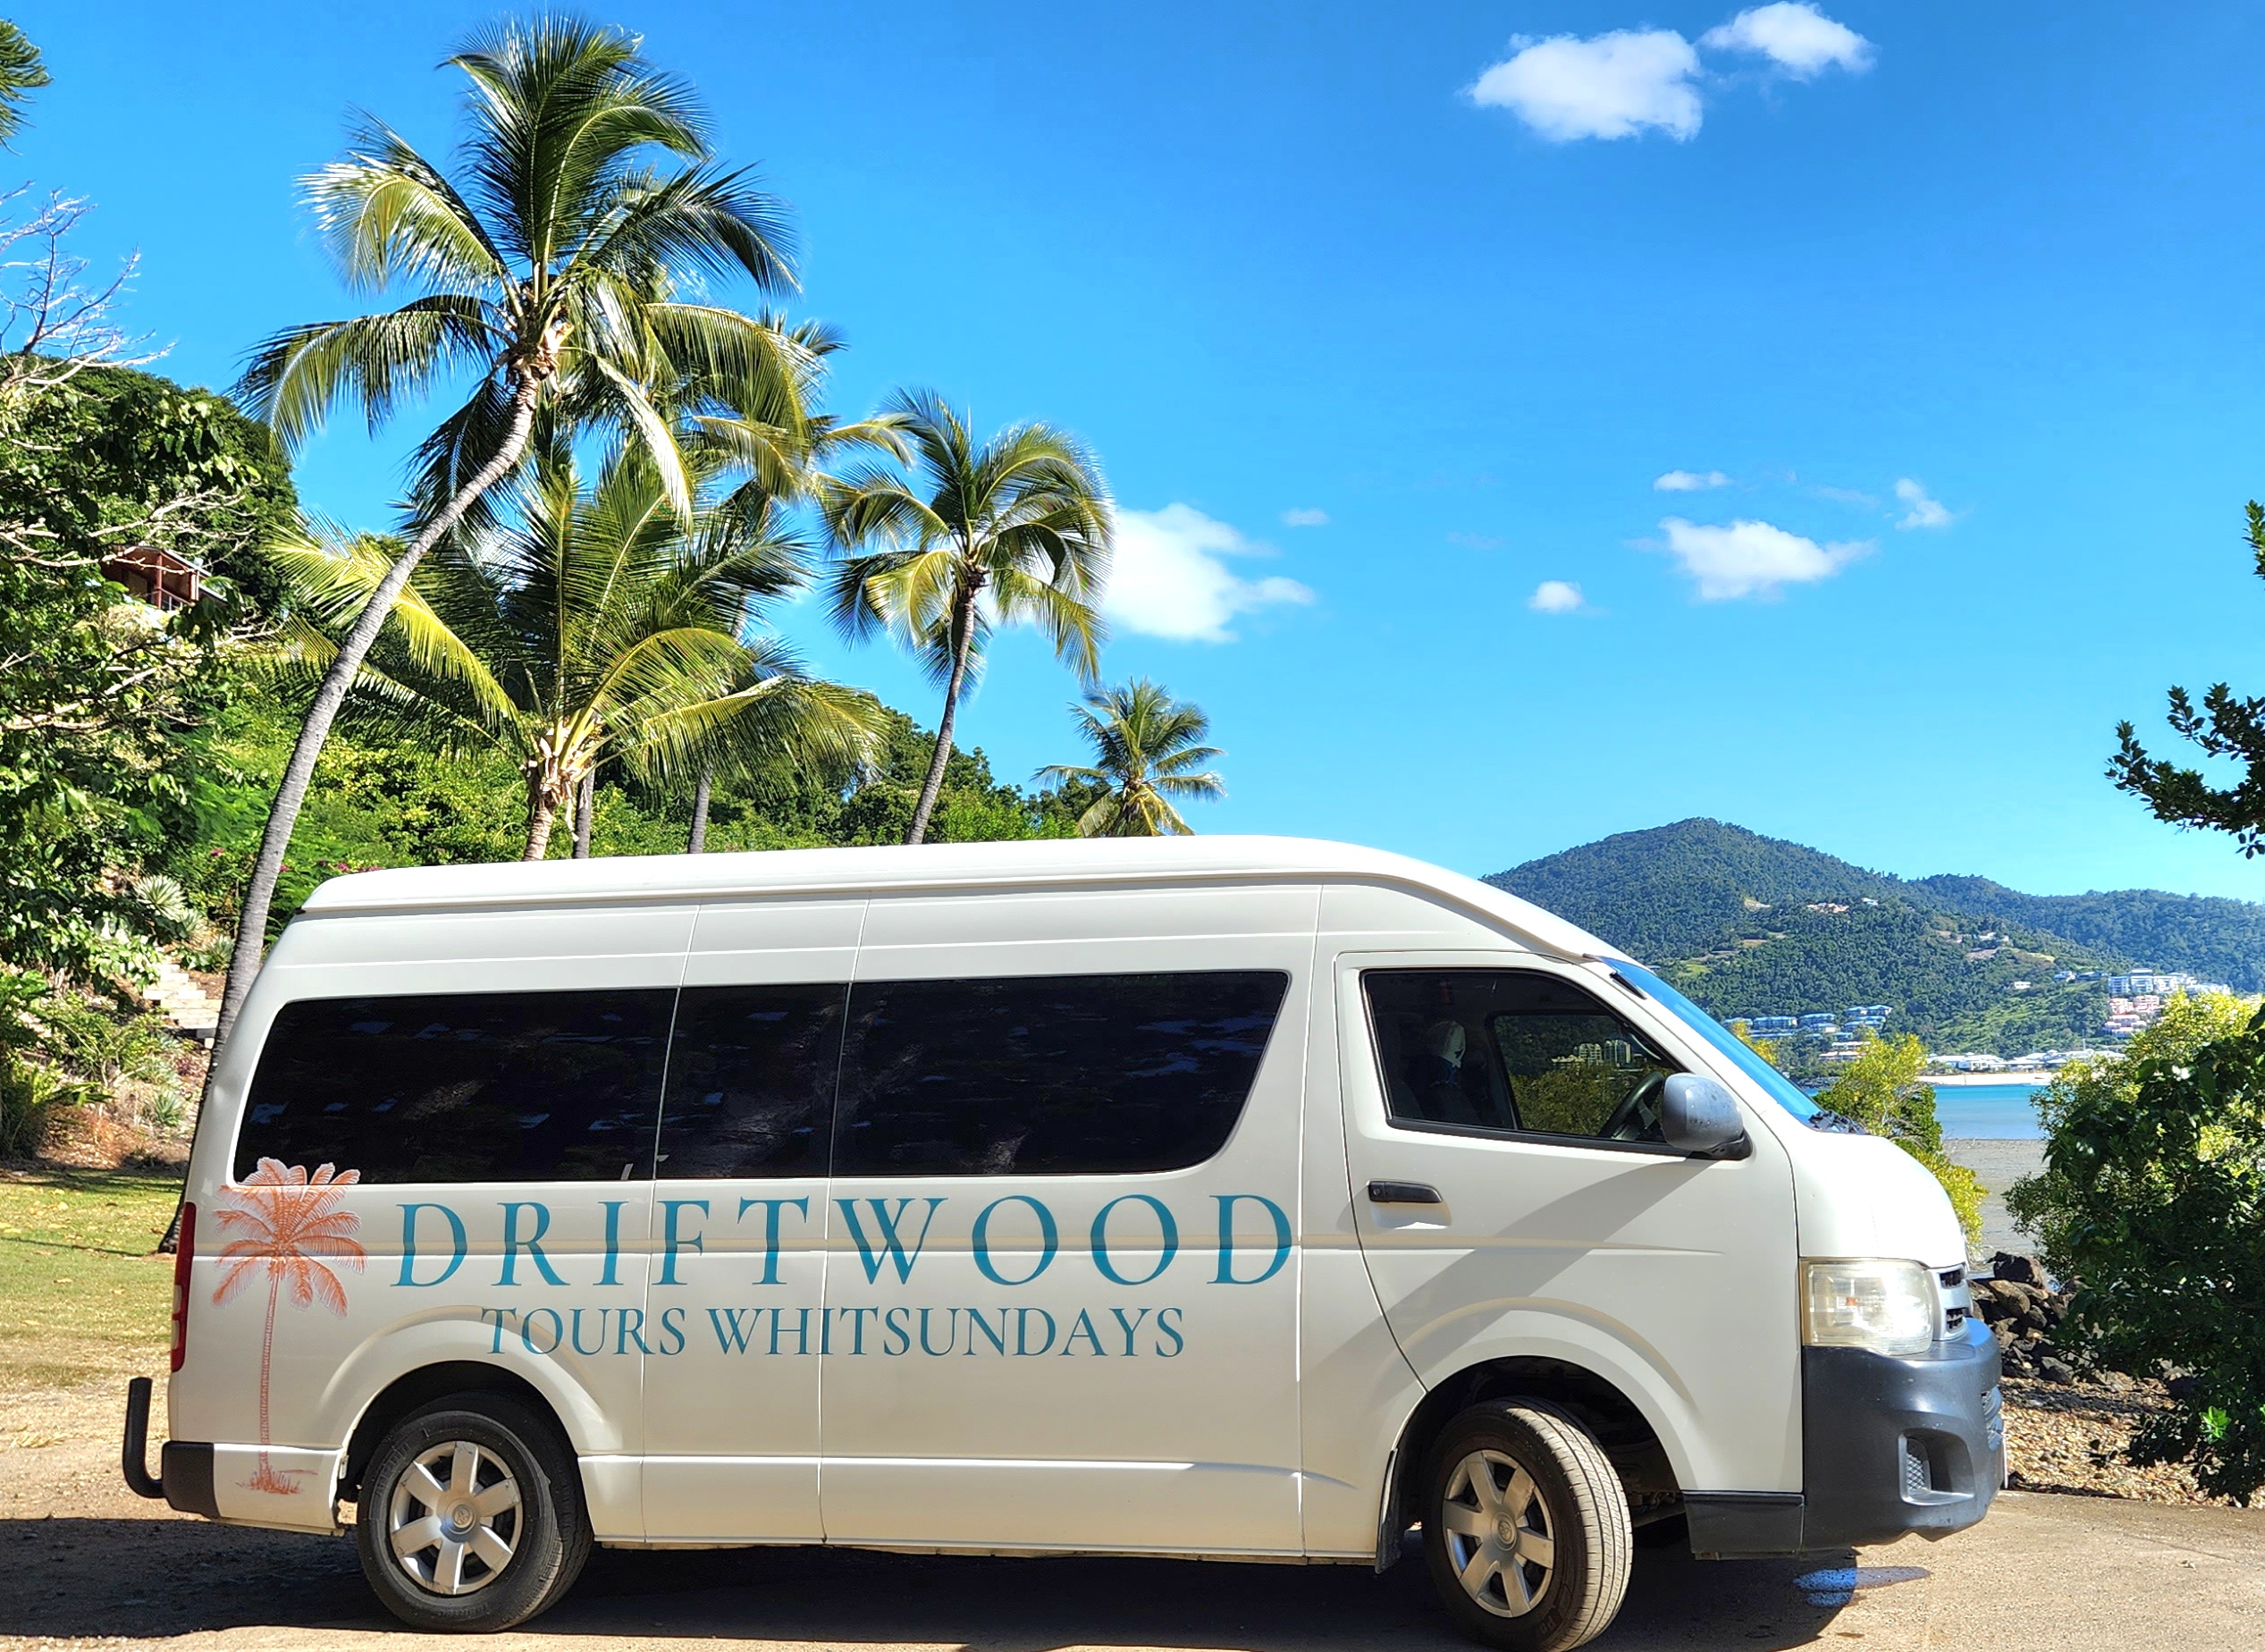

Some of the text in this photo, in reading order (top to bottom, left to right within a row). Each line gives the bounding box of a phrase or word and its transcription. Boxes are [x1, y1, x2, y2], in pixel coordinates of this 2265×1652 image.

[391, 1194, 1292, 1287] DRIFTWOOD
[482, 1307, 1184, 1358] TOURS WHITSUNDAYS
